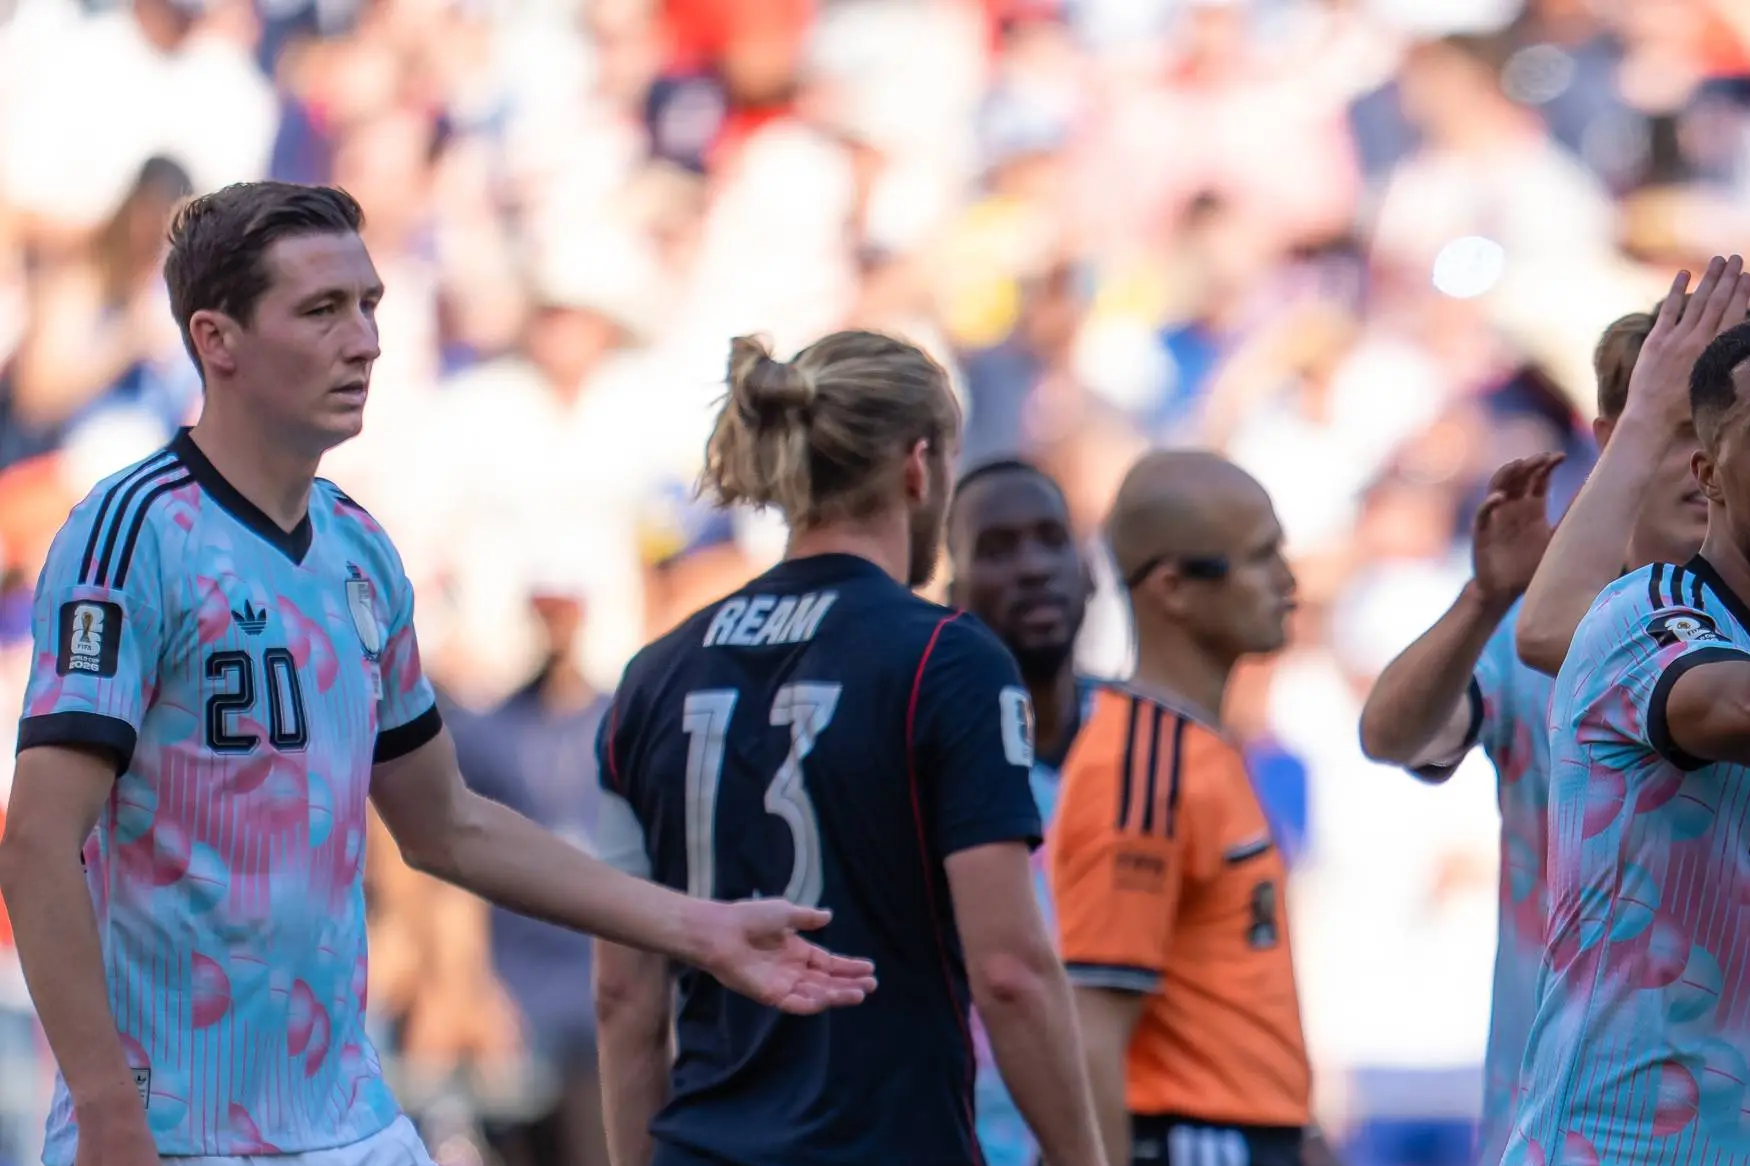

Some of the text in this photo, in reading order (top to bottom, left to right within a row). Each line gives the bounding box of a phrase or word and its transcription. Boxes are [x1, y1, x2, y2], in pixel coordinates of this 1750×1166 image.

[703, 591, 838, 648] REAM
[205, 647, 309, 756] 20
[682, 681, 842, 909] 13
